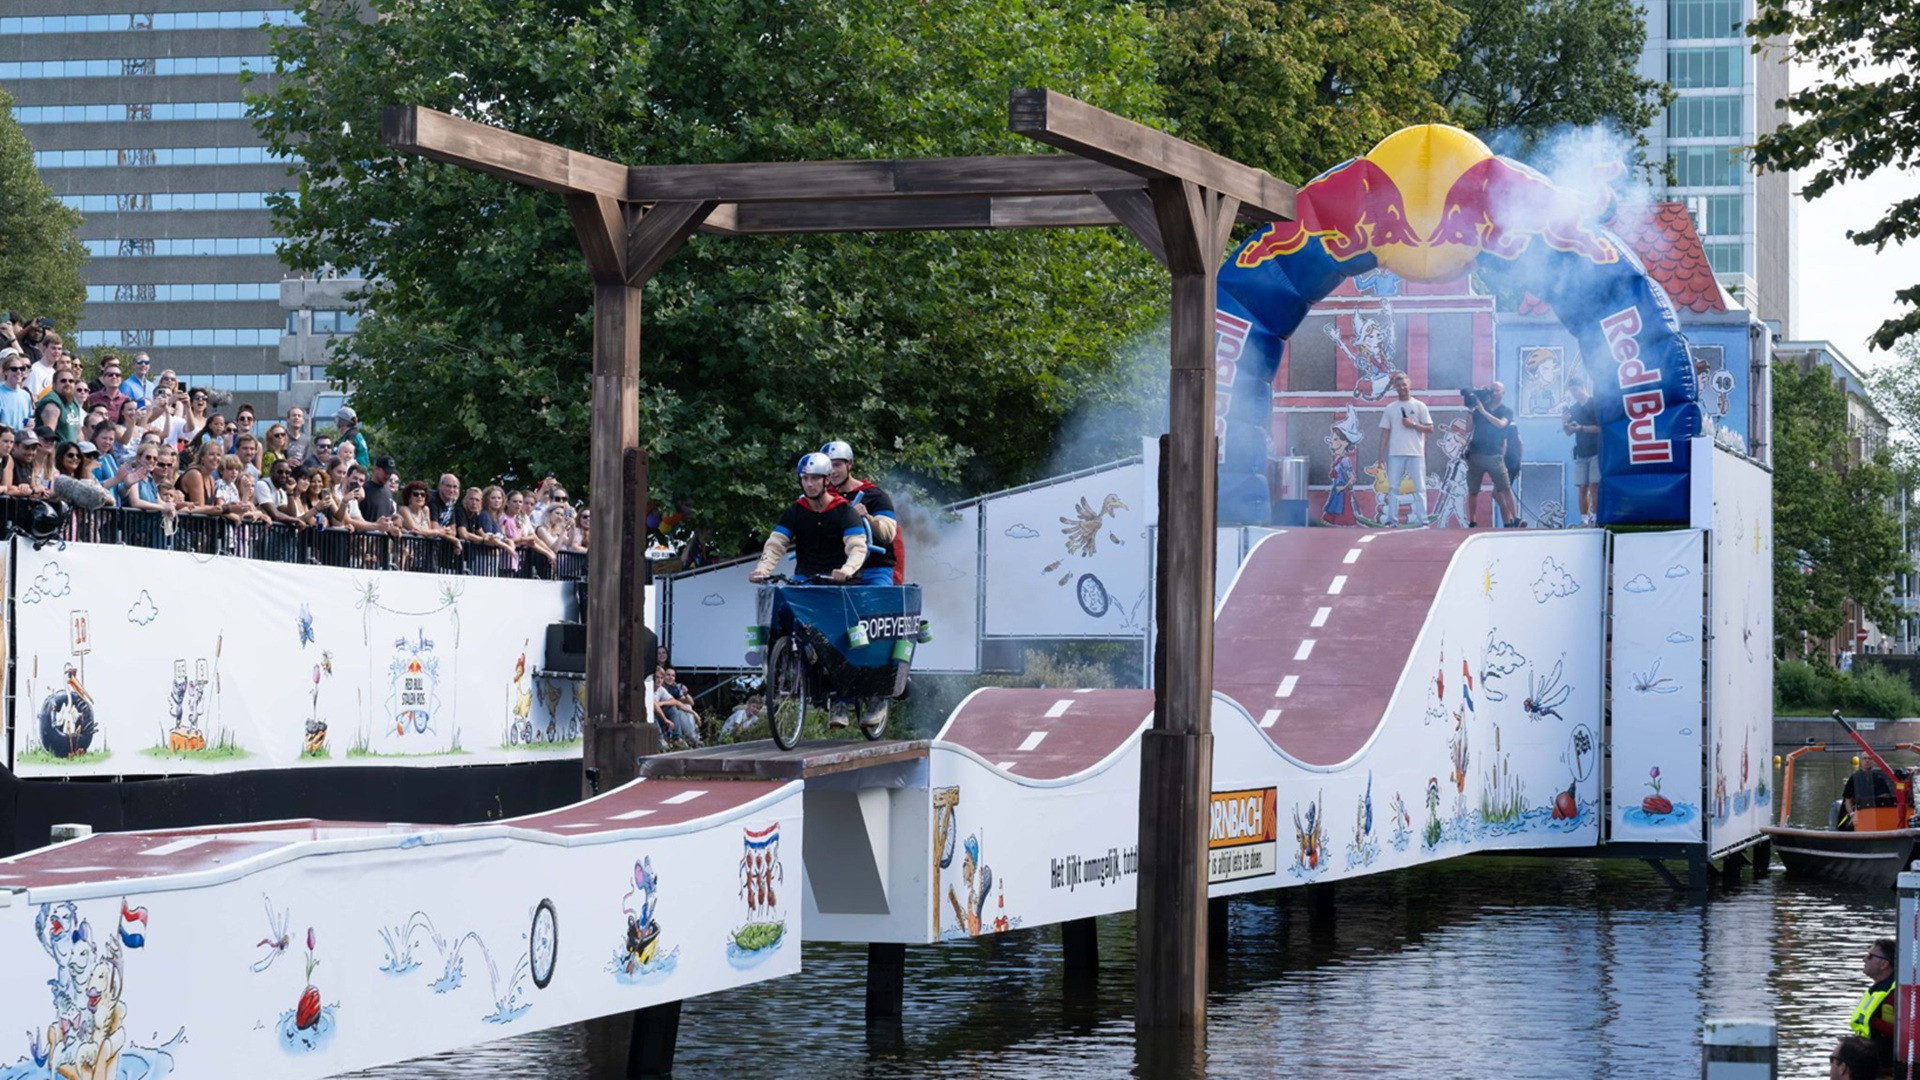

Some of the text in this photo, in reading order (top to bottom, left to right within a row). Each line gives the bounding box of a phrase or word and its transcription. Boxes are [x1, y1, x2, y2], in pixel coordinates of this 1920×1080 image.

[1600, 305, 1673, 465] Red Bull
[75, 617, 86, 644] 10
[405, 678, 423, 690] RED BULL
[1209, 797, 1263, 840] RNBACH
[1051, 858, 1064, 889] Het
[1066, 855, 1082, 892] lijkt
[1083, 848, 1122, 888] onmogelijk,
